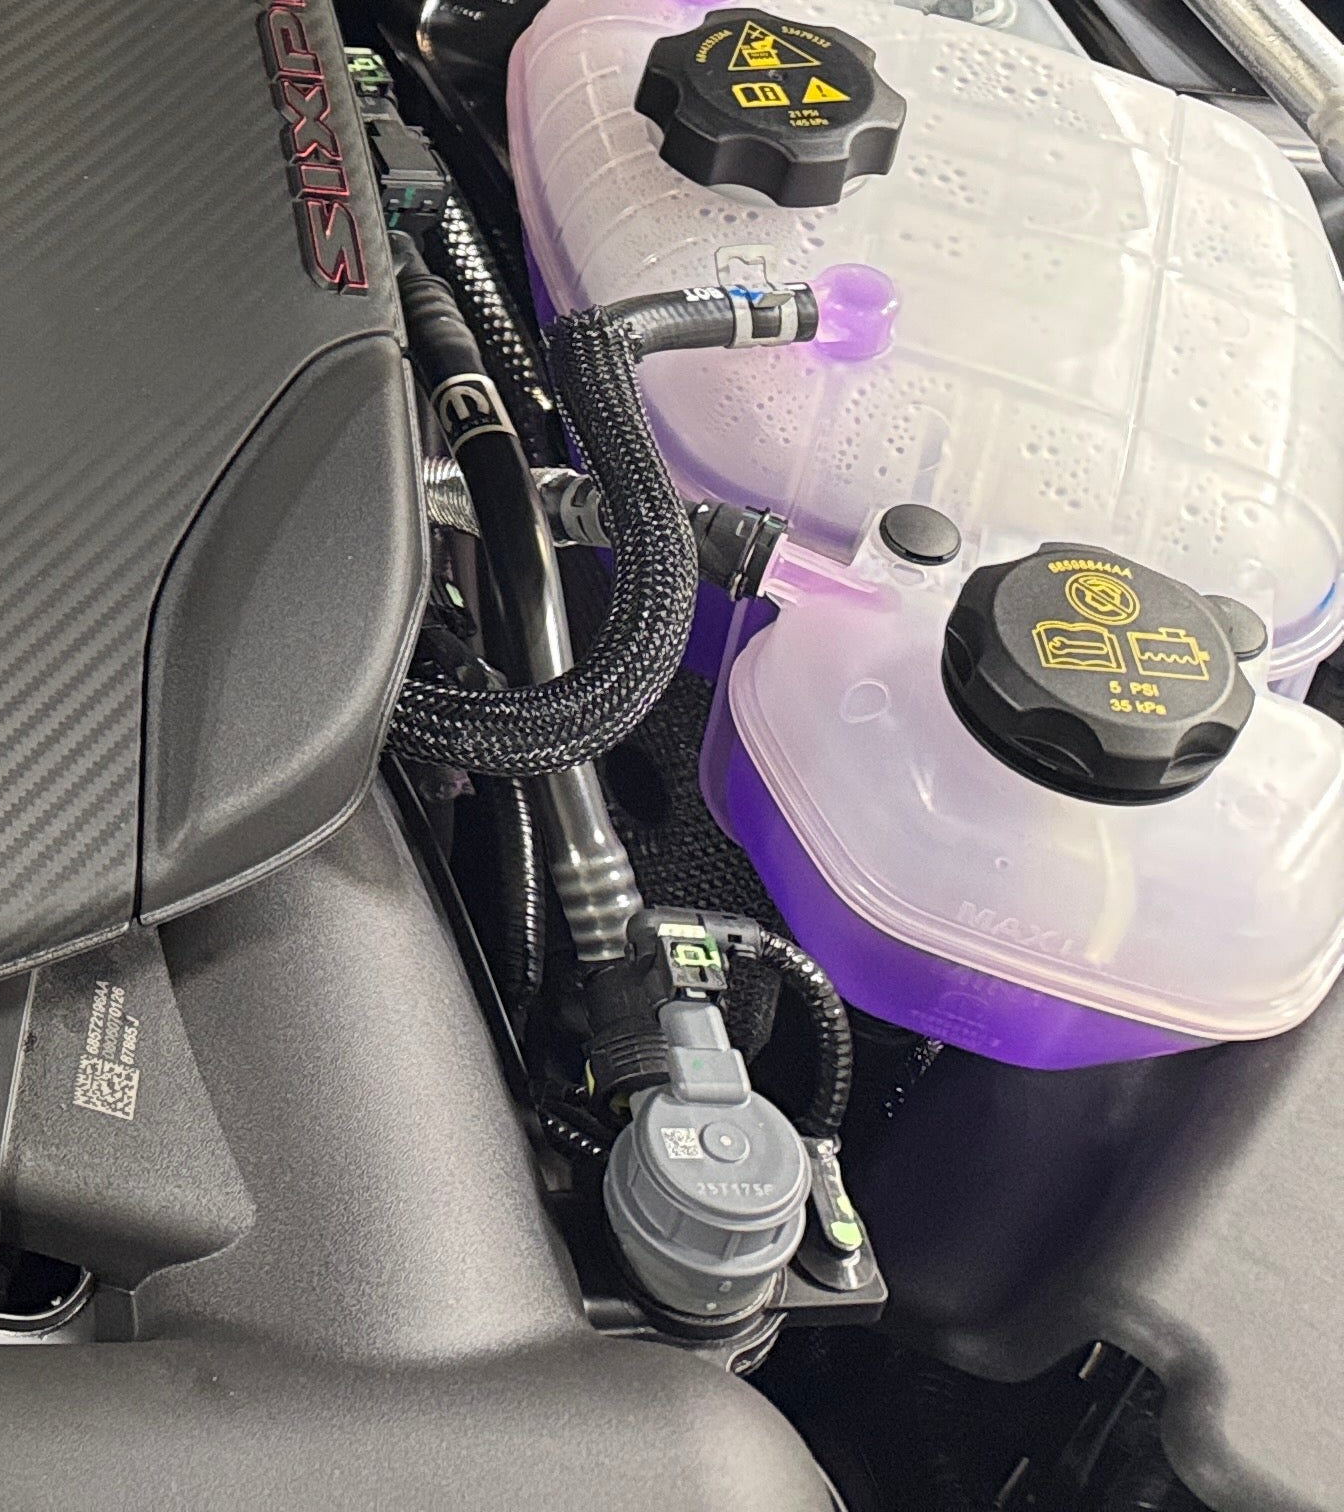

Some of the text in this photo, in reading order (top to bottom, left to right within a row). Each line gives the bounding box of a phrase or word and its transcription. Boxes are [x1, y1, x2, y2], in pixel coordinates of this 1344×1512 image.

[1109, 680, 1160, 697] 5 PSI
[1109, 699, 1167, 716] 35 kPa
